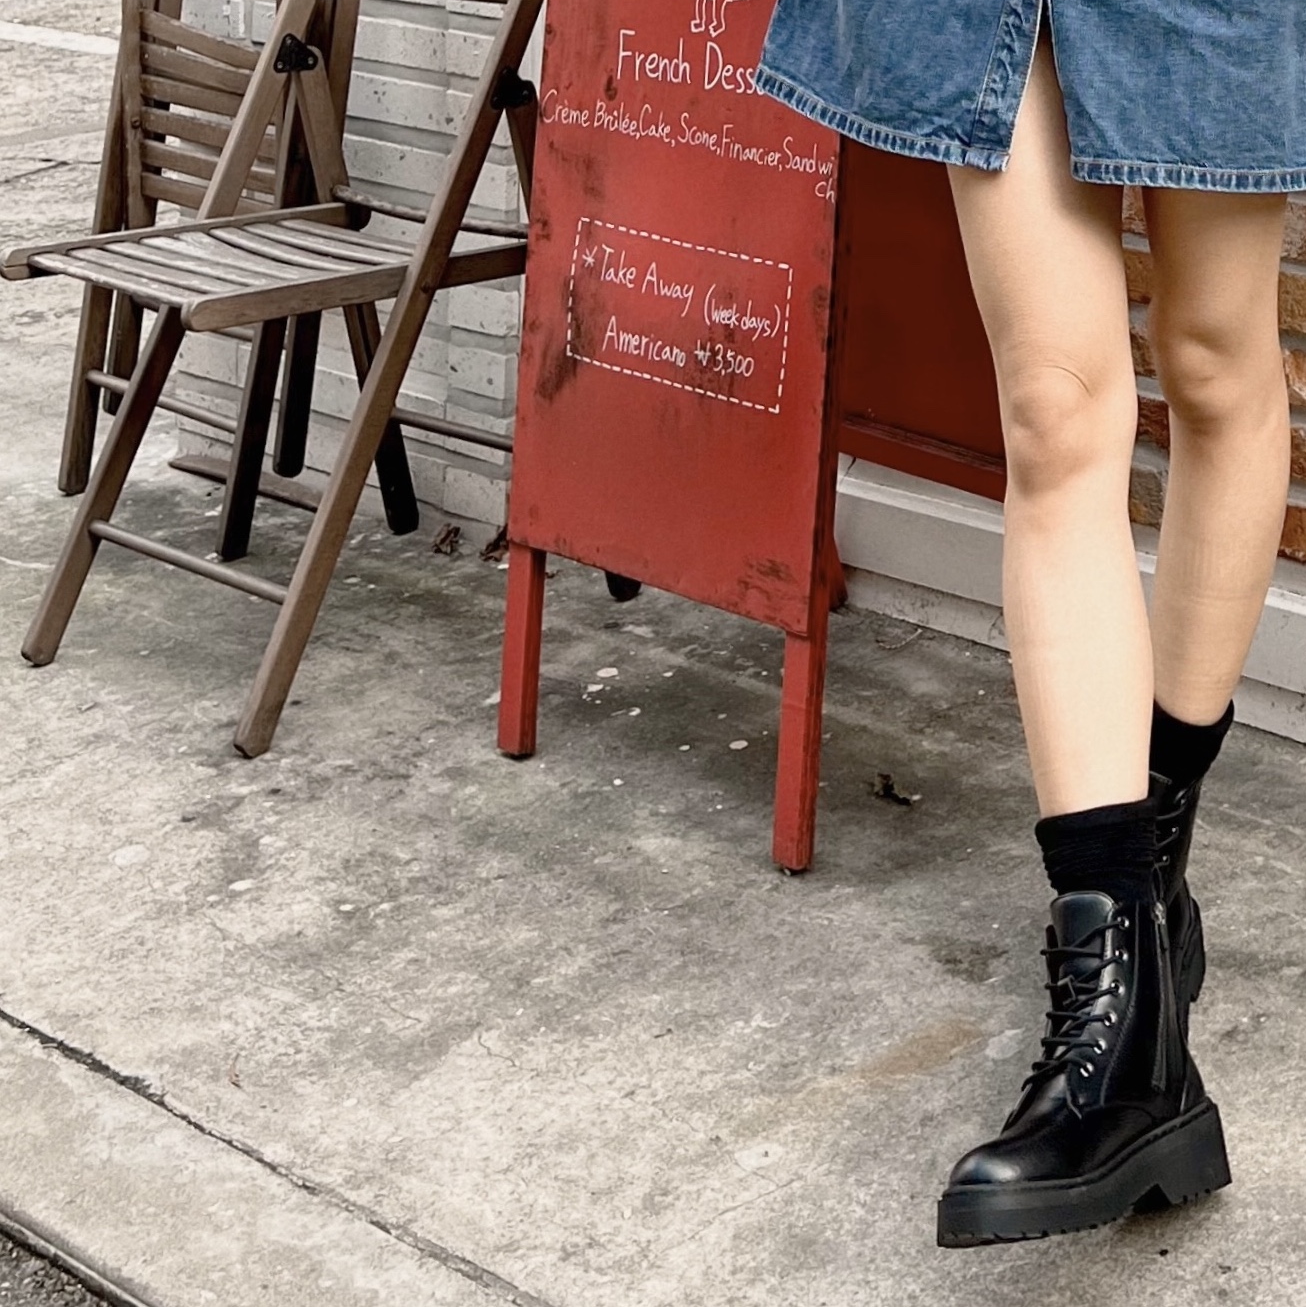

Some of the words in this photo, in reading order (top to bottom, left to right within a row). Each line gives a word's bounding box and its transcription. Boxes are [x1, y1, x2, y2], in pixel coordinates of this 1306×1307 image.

[617, 29, 691, 84] French
[541, 89, 591, 127] Crème
[677, 112, 720, 155] Scone,
[720, 124, 782, 171] Financier,
[601, 244, 636, 288] Take
[642, 262, 694, 317] Away
[602, 315, 687, 367] Americano
